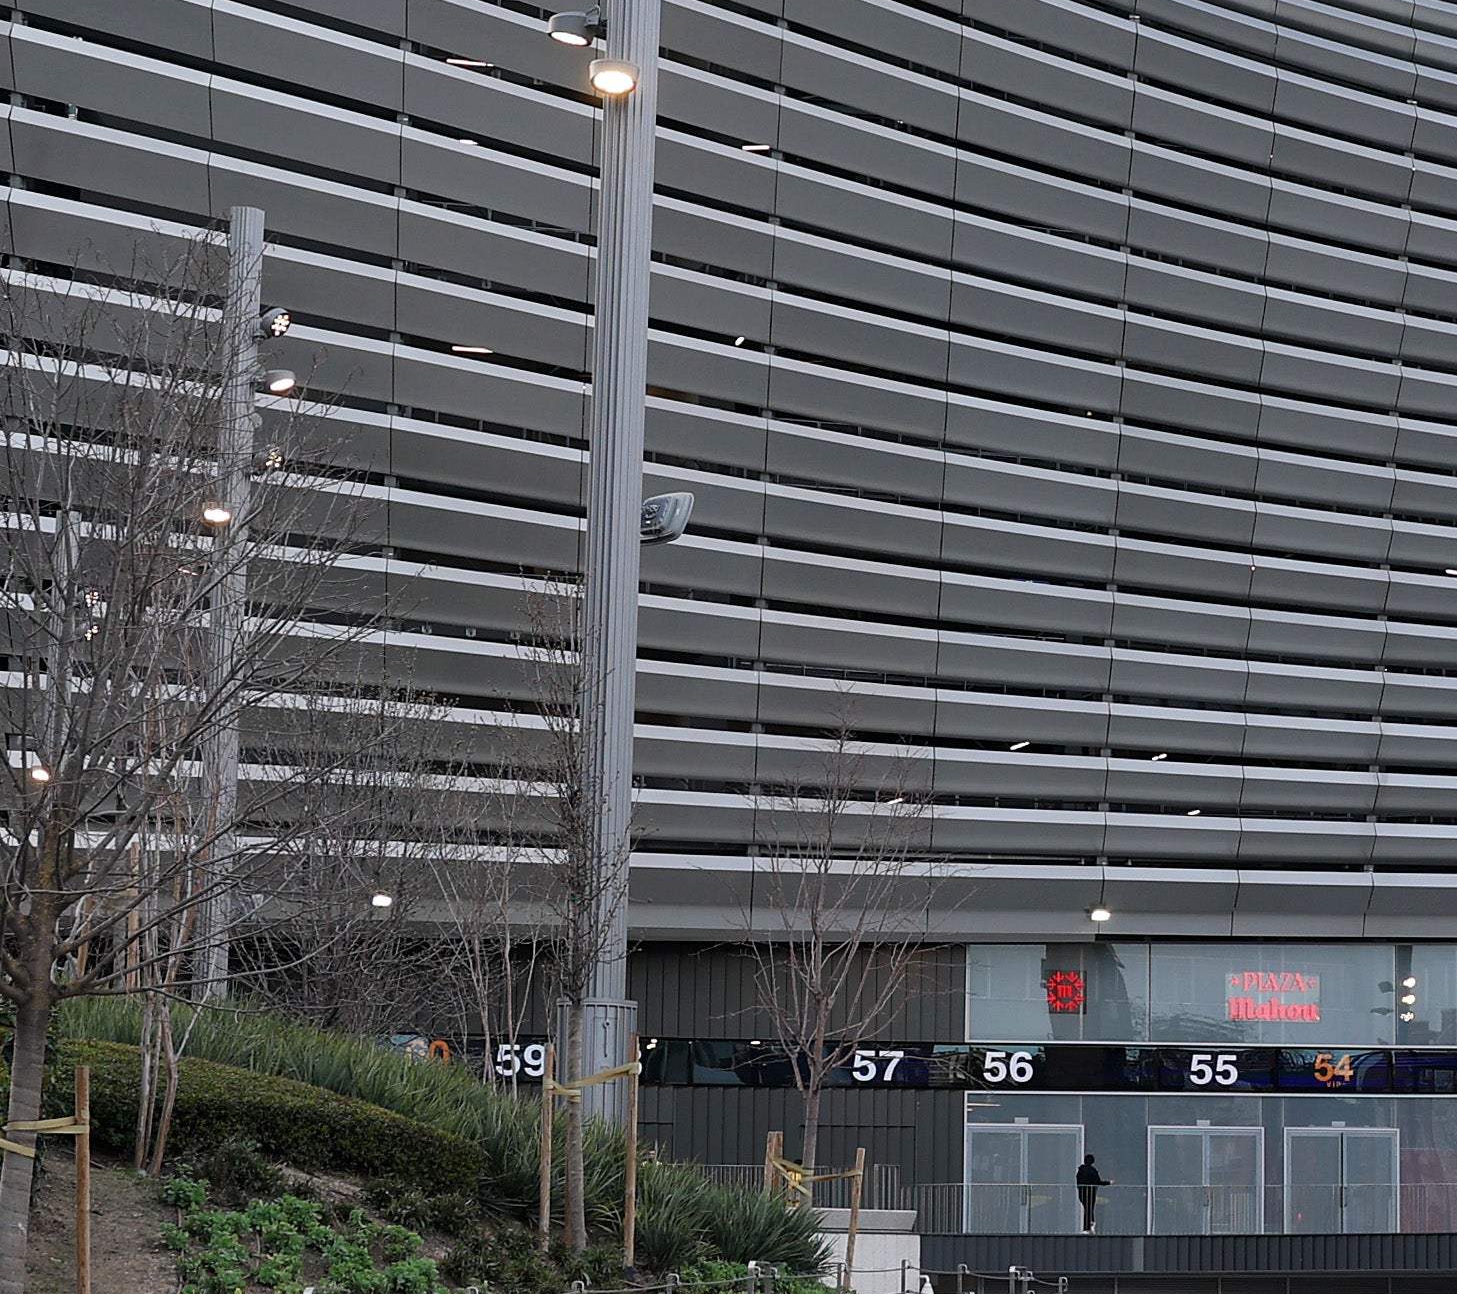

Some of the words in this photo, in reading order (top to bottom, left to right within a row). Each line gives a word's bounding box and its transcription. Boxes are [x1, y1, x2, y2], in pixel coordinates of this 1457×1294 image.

[1242, 971, 1307, 992] PLAZA
[1228, 996, 1320, 1021] Mahou
[495, 1044, 544, 1077] 59
[852, 1050, 905, 1082] 57
[982, 1051, 1034, 1083] 56
[1189, 1054, 1239, 1085] 55
[1313, 1053, 1354, 1082] 54
[1326, 1080, 1342, 1088] VIP
